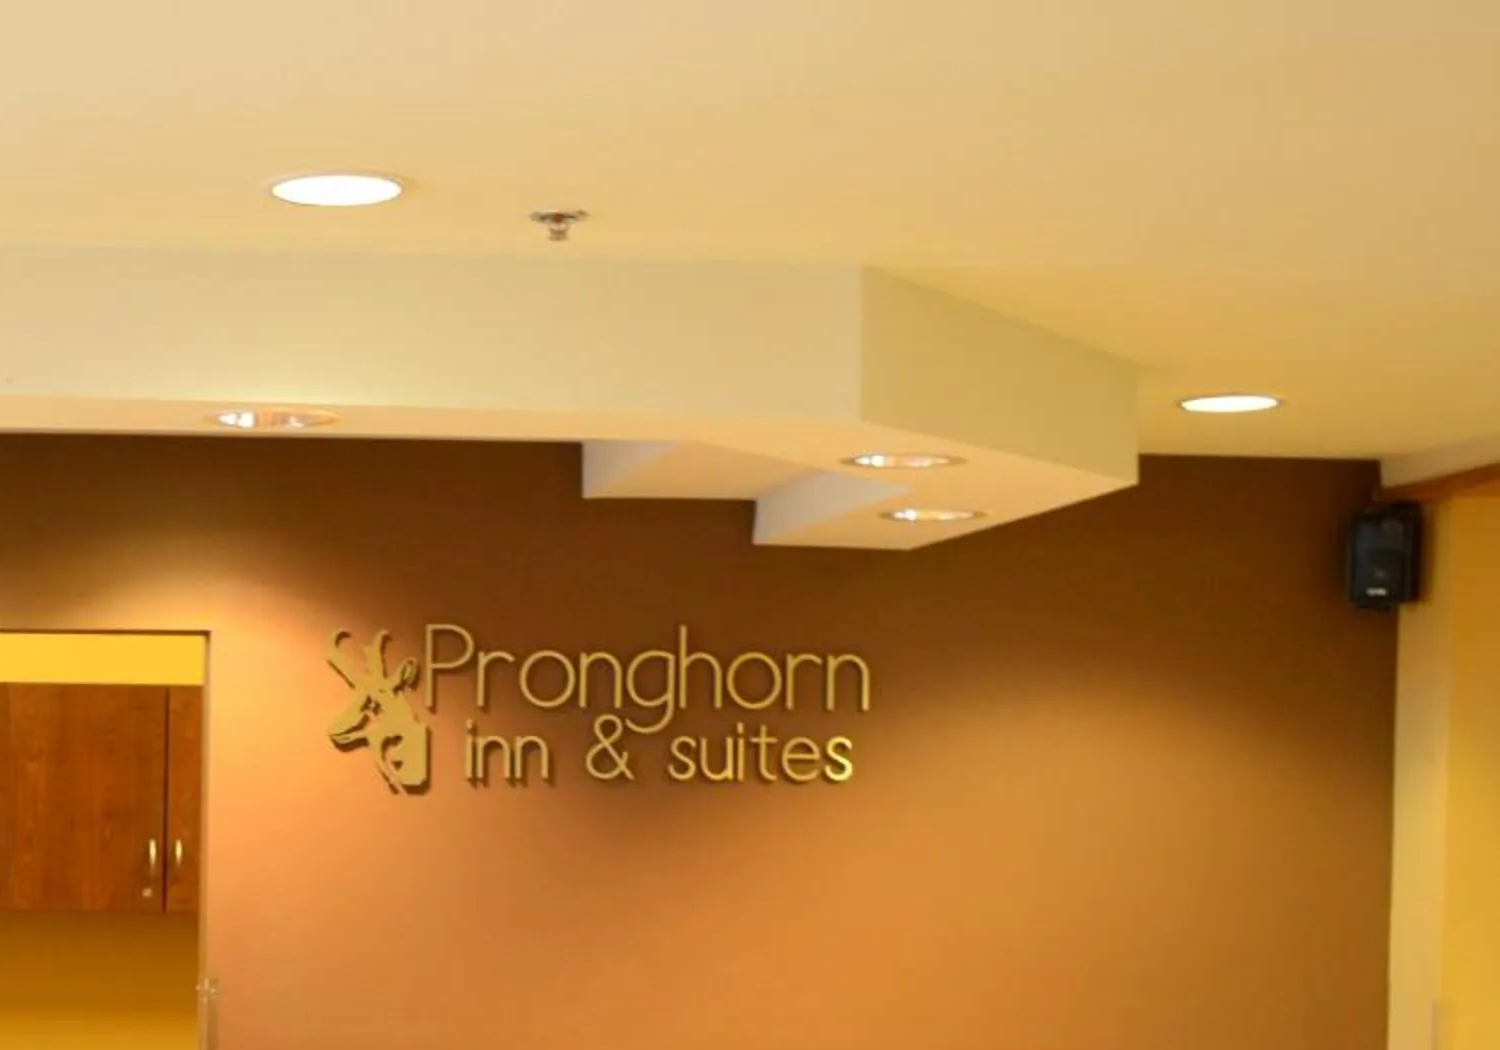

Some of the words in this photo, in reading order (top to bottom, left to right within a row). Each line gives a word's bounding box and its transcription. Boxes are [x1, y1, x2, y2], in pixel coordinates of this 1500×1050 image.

[424, 622, 872, 735] Pronghorn
[464, 719, 550, 781] inn
[585, 714, 635, 781] &
[667, 721, 854, 783] suites
